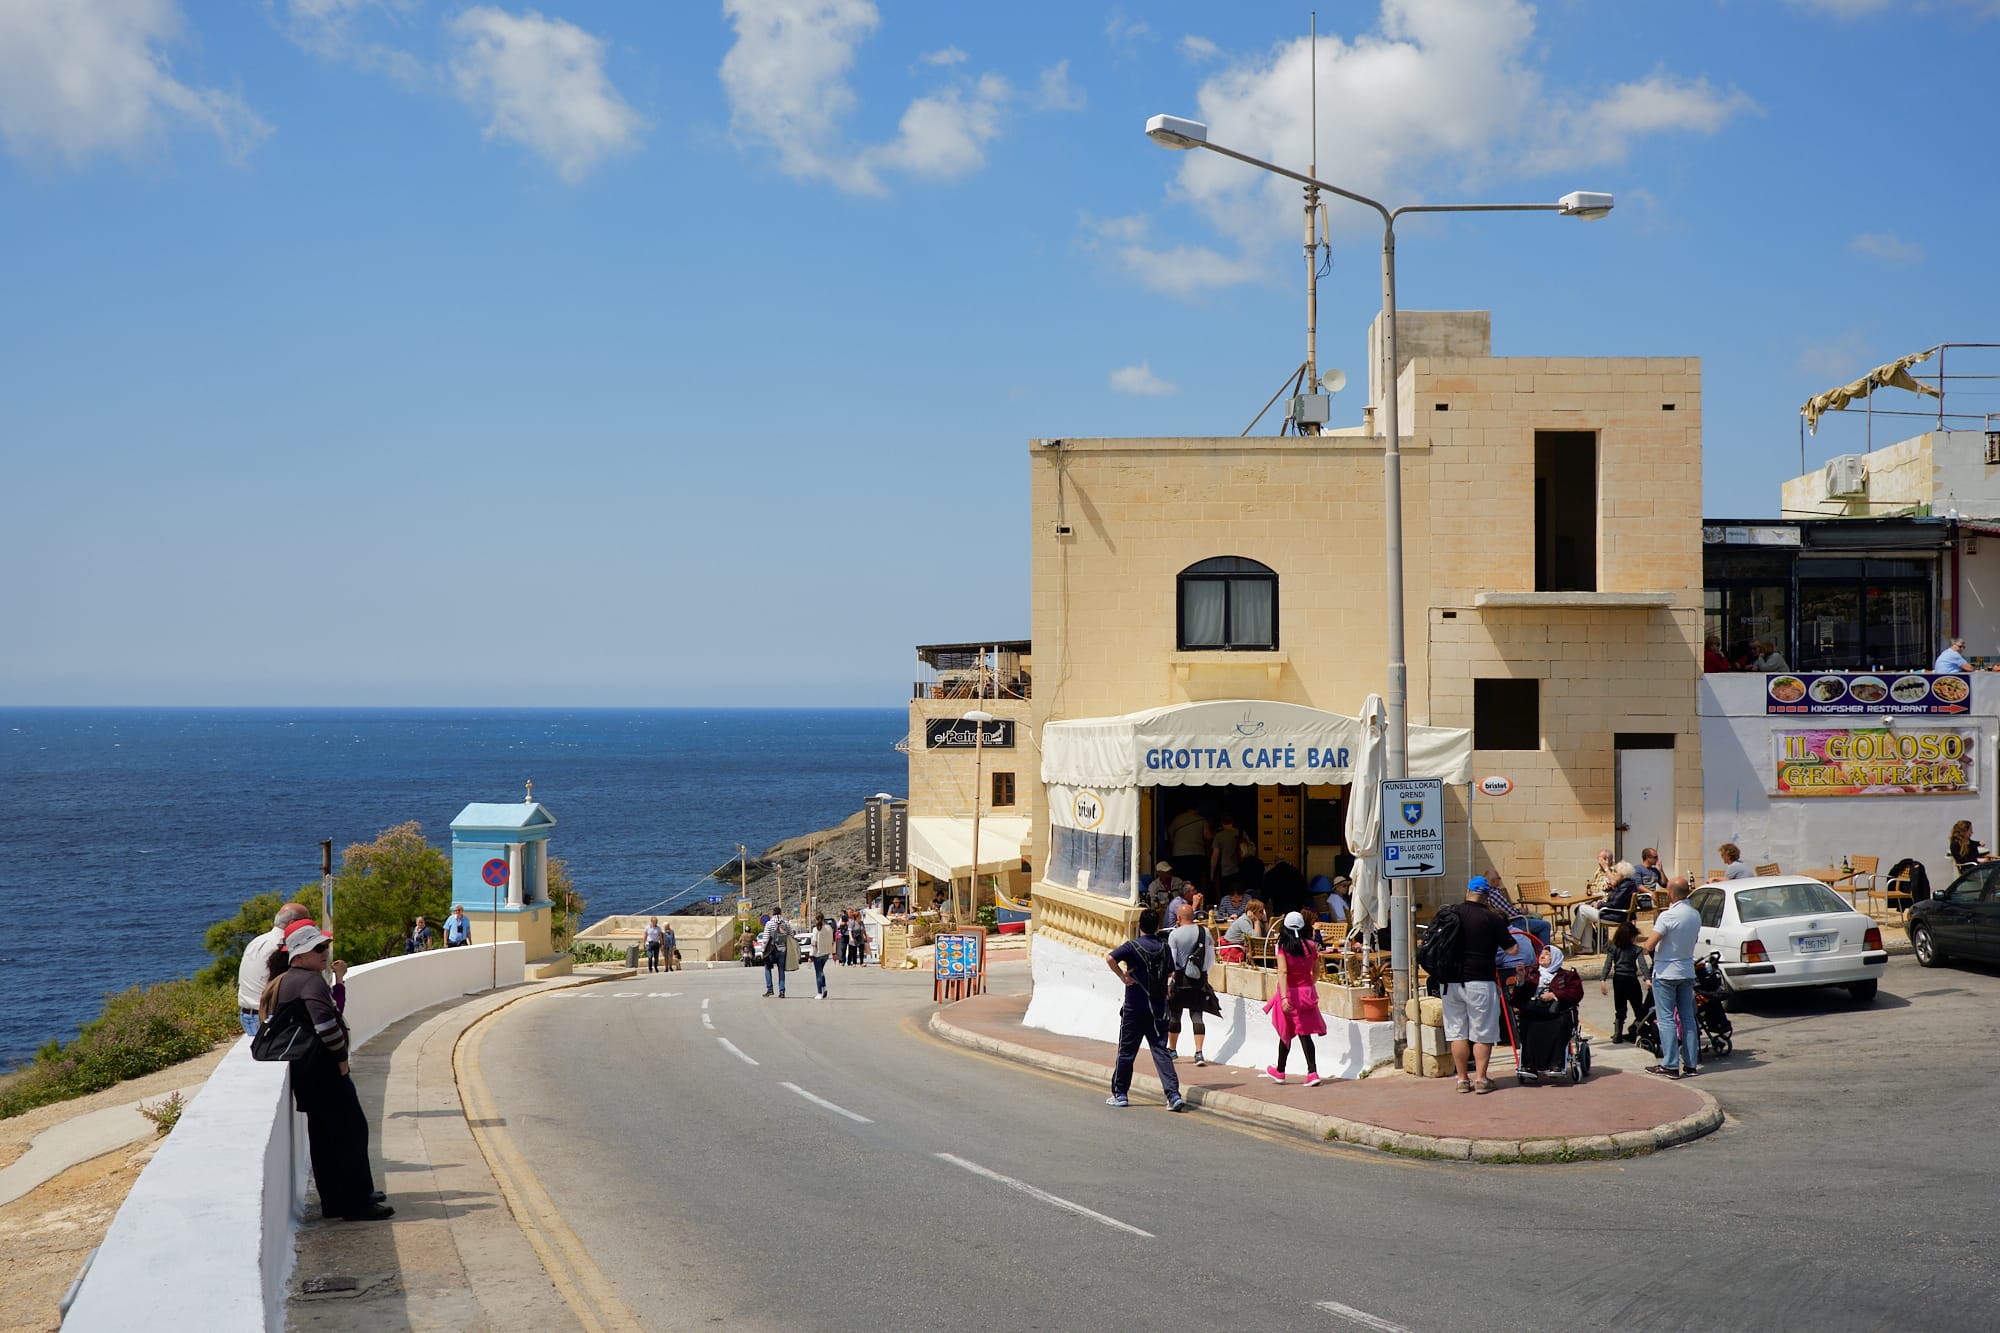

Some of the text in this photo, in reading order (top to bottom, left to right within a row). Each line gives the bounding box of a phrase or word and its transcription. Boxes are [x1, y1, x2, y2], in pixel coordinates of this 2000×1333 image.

[1811, 705, 1928, 713] KINGFISHER RESTAURANT
[1784, 734, 1964, 762] IL GOLOSO
[1145, 743, 1349, 769] GROTTA CAFÉ BAR
[1783, 764, 1968, 787] GELATERIA
[1415, 781, 1439, 789] LOKALI
[1400, 791, 1425, 799] QRENDI
[1417, 843, 1442, 851] GROTTO
[1389, 847, 1397, 860] P
